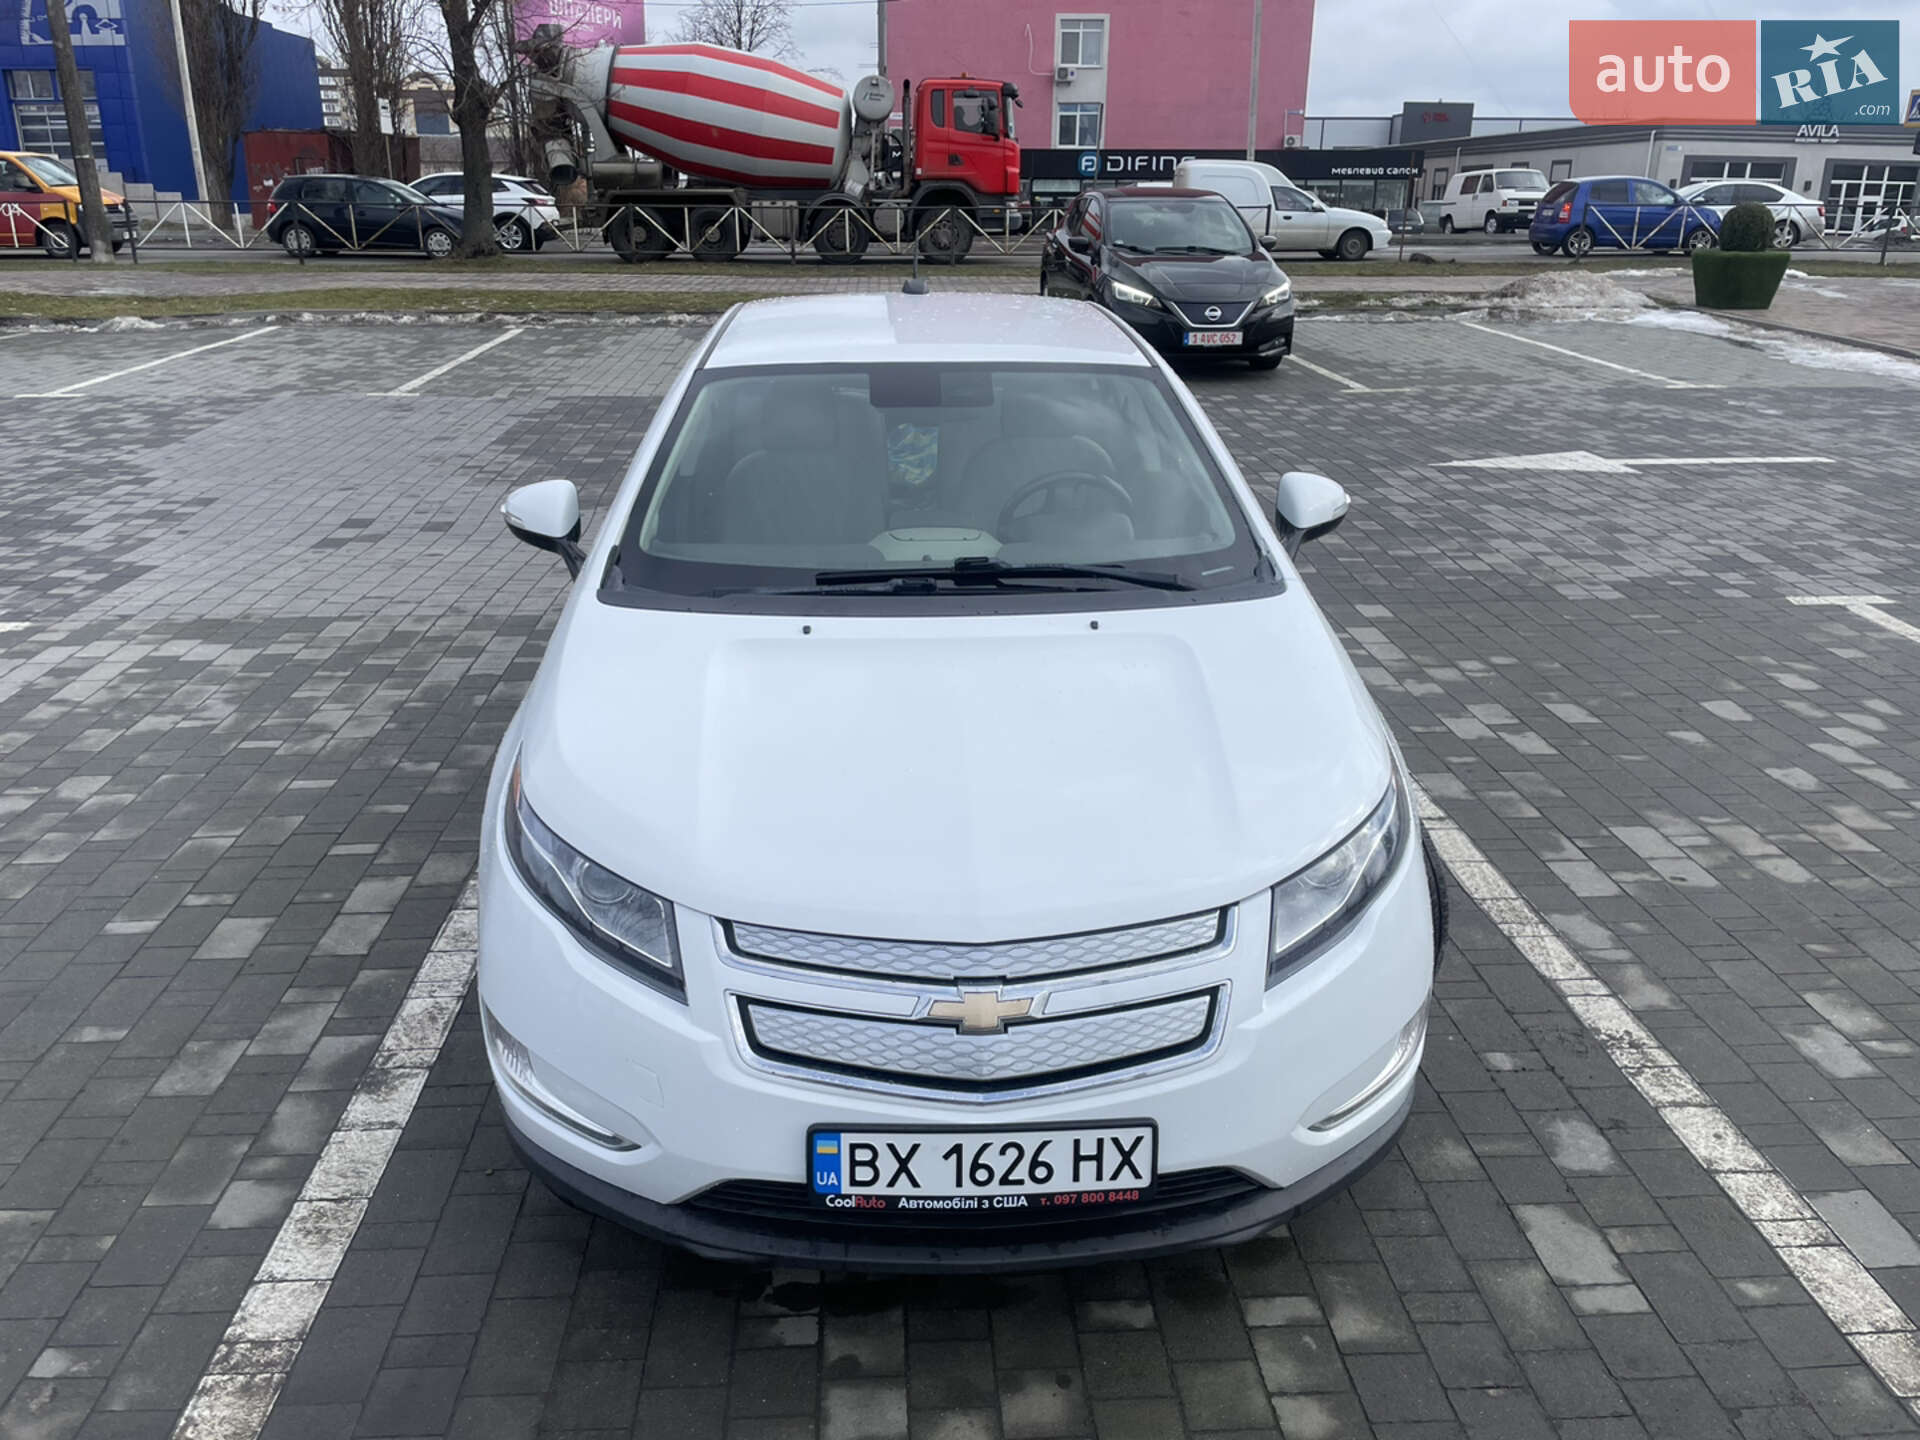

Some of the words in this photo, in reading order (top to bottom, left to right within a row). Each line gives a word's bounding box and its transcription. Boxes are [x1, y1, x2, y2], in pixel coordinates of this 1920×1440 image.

[1796, 124, 1840, 137] AVILA
[1106, 155, 1196, 172] DIFIN
[849, 1142, 922, 1188] BX
[942, 1139, 1054, 1188] 1626
[1072, 1135, 1145, 1184] HX
[816, 1171, 839, 1187] UA
[898, 1196, 978, 1209] Автомобілі
[993, 1195, 1028, 1208] США
[1054, 1194, 1078, 1205] 097
[1081, 1191, 1104, 1204] 800
[1108, 1189, 1139, 1201] 8448
